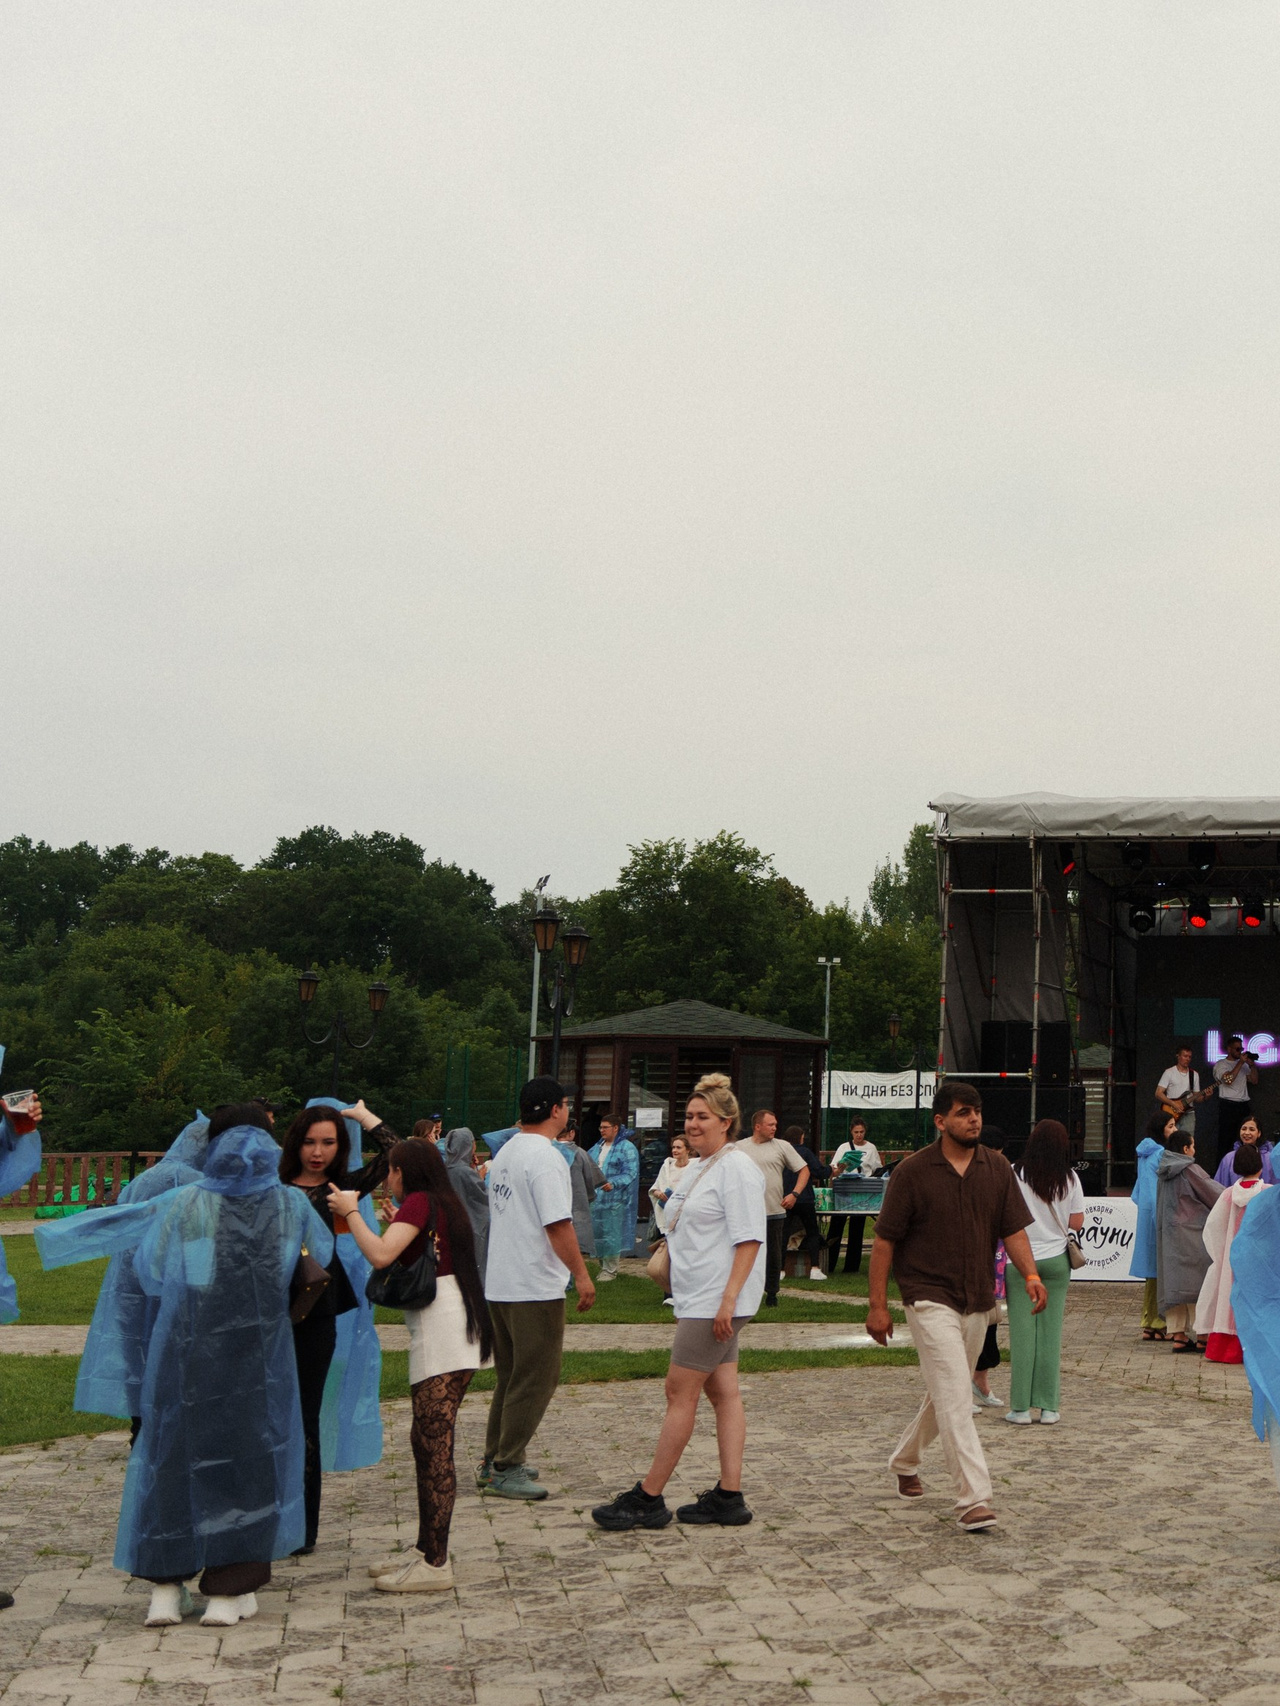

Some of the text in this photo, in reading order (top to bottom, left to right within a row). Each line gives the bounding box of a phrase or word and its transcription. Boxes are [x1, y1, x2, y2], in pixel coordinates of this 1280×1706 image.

[842, 1084, 858, 1096] НИ
[861, 1085, 887, 1098] ДНЯ
[891, 1084, 914, 1097] БЕЗ
[1085, 1204, 1114, 1215] пекарня
[1068, 1226, 1134, 1250] рауни
[1085, 1251, 1121, 1269] дитерская
